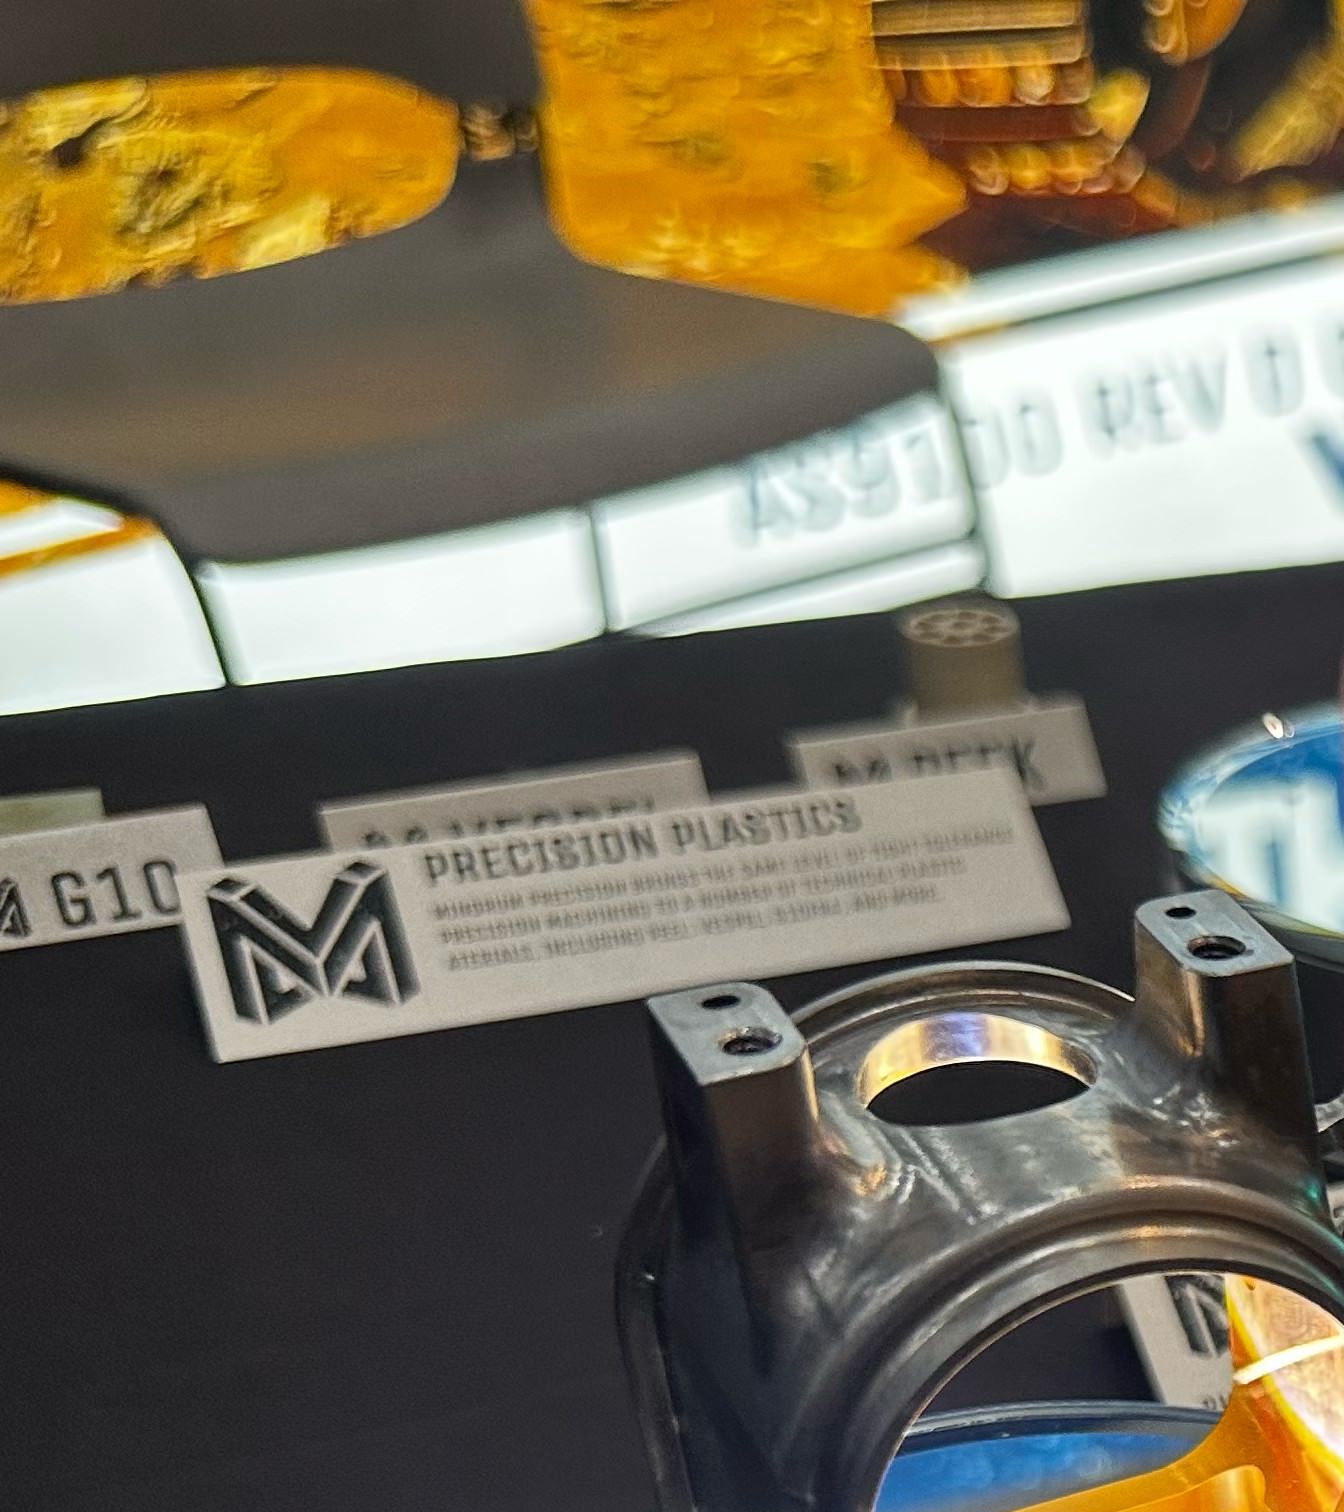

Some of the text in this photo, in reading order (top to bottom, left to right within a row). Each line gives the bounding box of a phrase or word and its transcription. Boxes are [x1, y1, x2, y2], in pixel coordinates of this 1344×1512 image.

[419, 820, 659, 889] PRECISION
[667, 793, 863, 854] PLASTICS
[52, 860, 181, 927] G10
